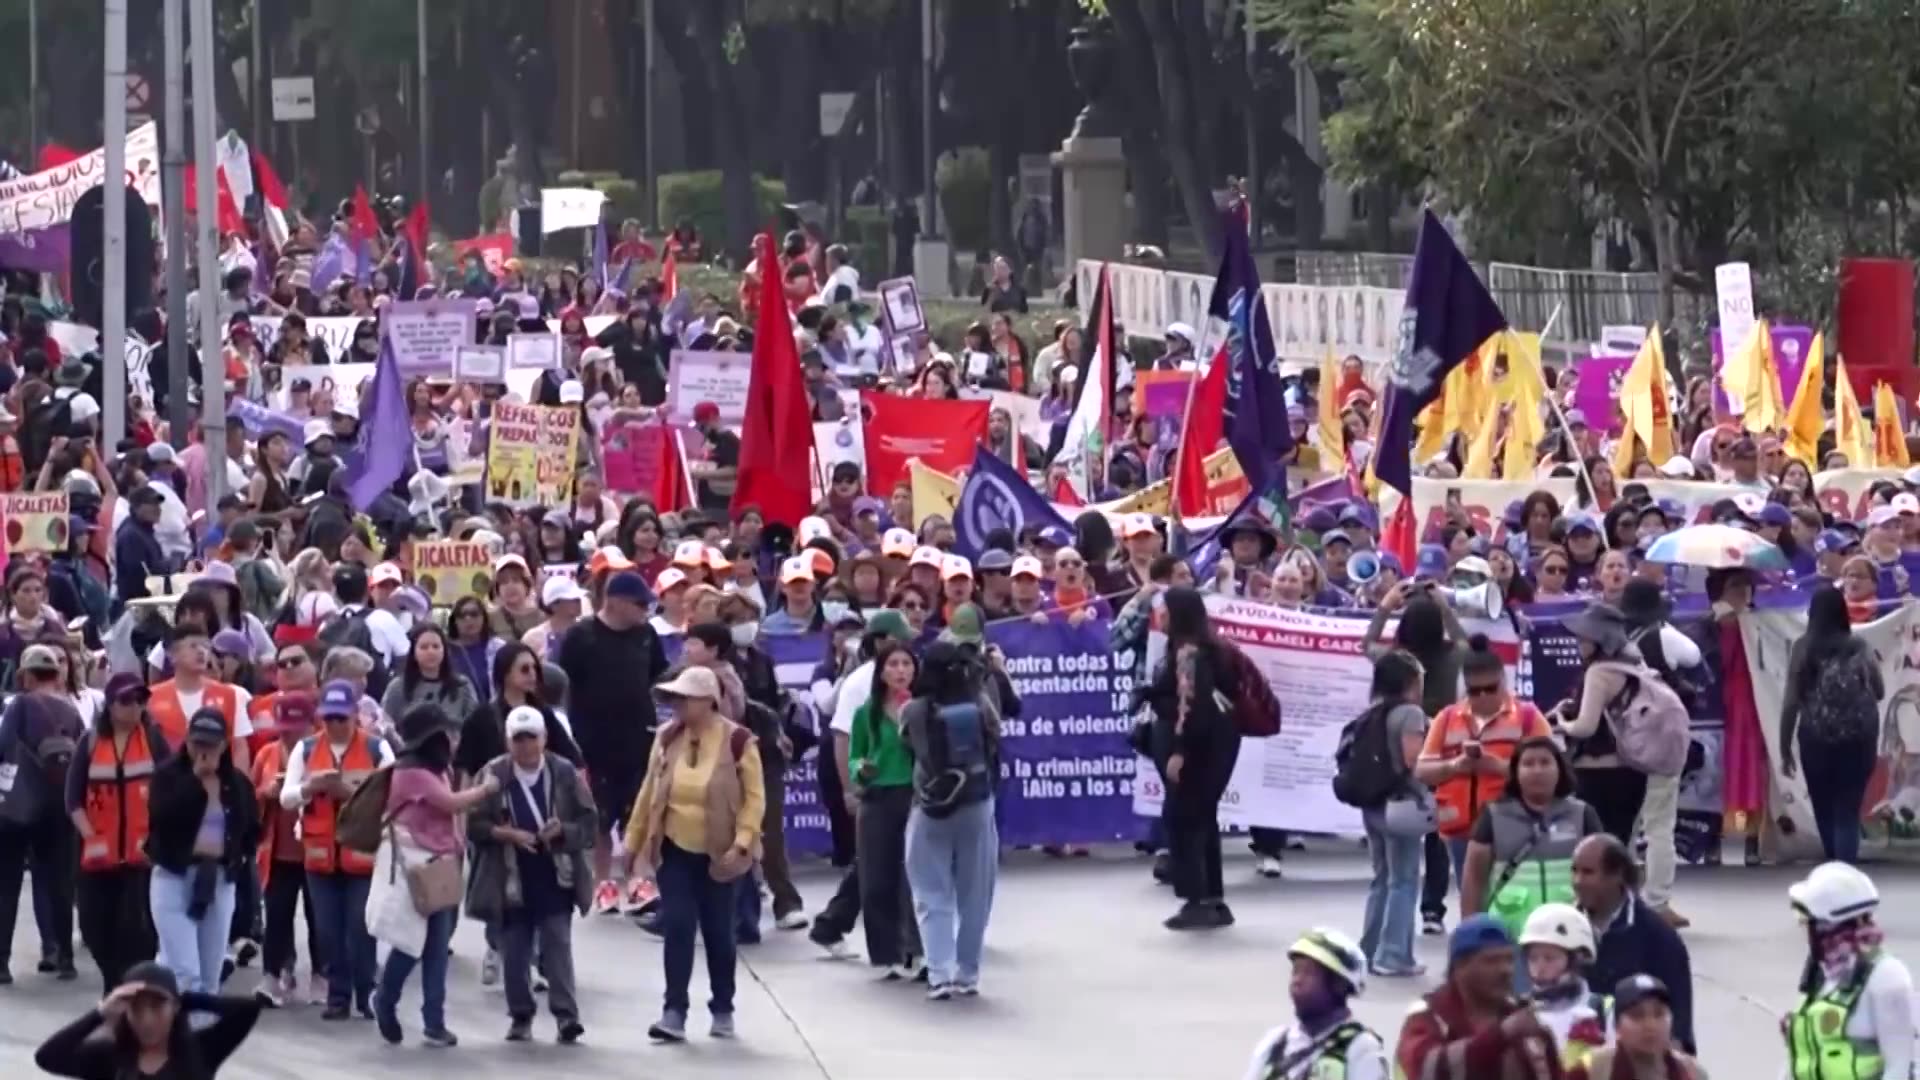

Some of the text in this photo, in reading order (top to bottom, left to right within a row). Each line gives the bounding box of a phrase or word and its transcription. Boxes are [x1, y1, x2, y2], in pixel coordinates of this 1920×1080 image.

[495, 404, 577, 428] REFRECOS
[417, 544, 489, 568] JICALETAS
[1318, 638, 1364, 653] GARC
[1006, 655, 1053, 673] ontra
[1058, 652, 1109, 672] todas
[1011, 674, 1133, 694] esentación co
[1000, 715, 1134, 737] sta de violenci
[1015, 758, 1031, 777] la
[1036, 756, 1134, 776] criminaliza
[1022, 779, 1065, 798] ¡Alto
[1070, 780, 1082, 797] a
[1087, 777, 1114, 796] los
